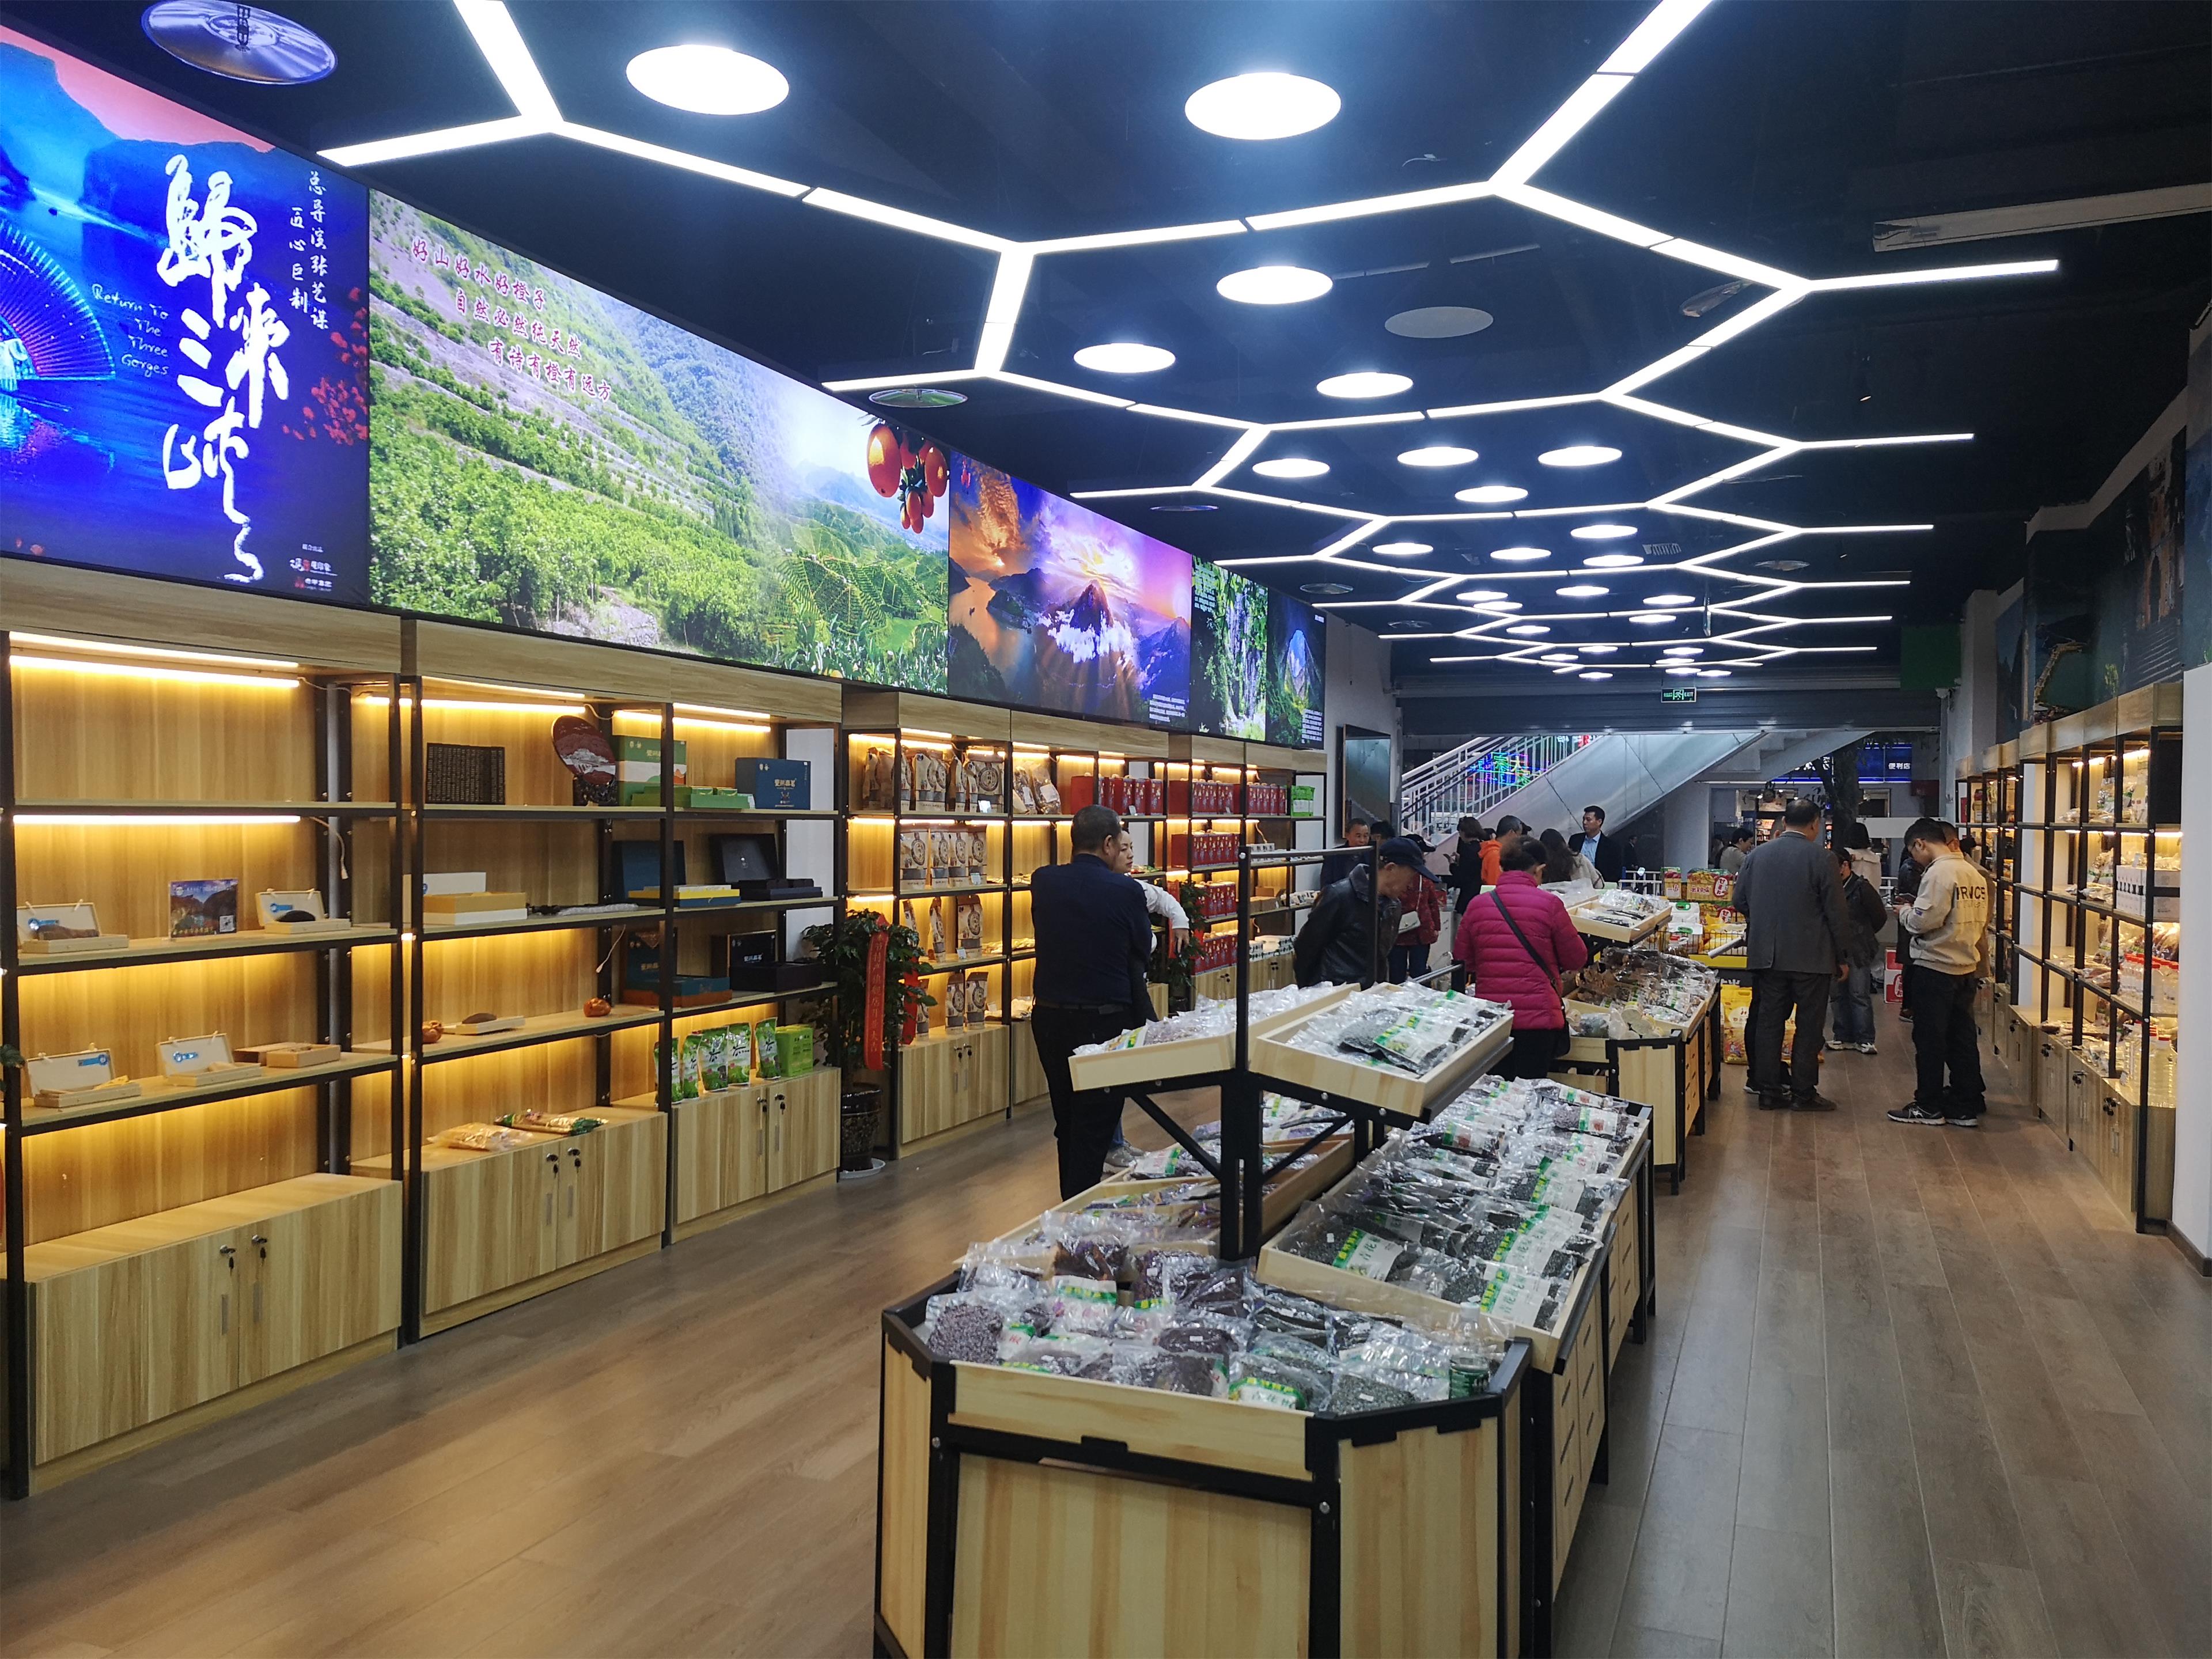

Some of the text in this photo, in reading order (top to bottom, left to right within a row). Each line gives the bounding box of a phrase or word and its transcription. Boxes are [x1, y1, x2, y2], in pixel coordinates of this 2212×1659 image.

[289, 207, 308, 313] 匠心巨制
[308, 171, 329, 330] 总导演张艺谋
[411, 237, 545, 311] 好山好水好橙子
[92, 283, 169, 320] Return To
[134, 318, 161, 336] The
[455, 287, 582, 358] 自然必然纯天然
[122, 354, 169, 378] Gorges
[128, 334, 169, 358] Three
[489, 339, 611, 402] 有诗有橙有远方
